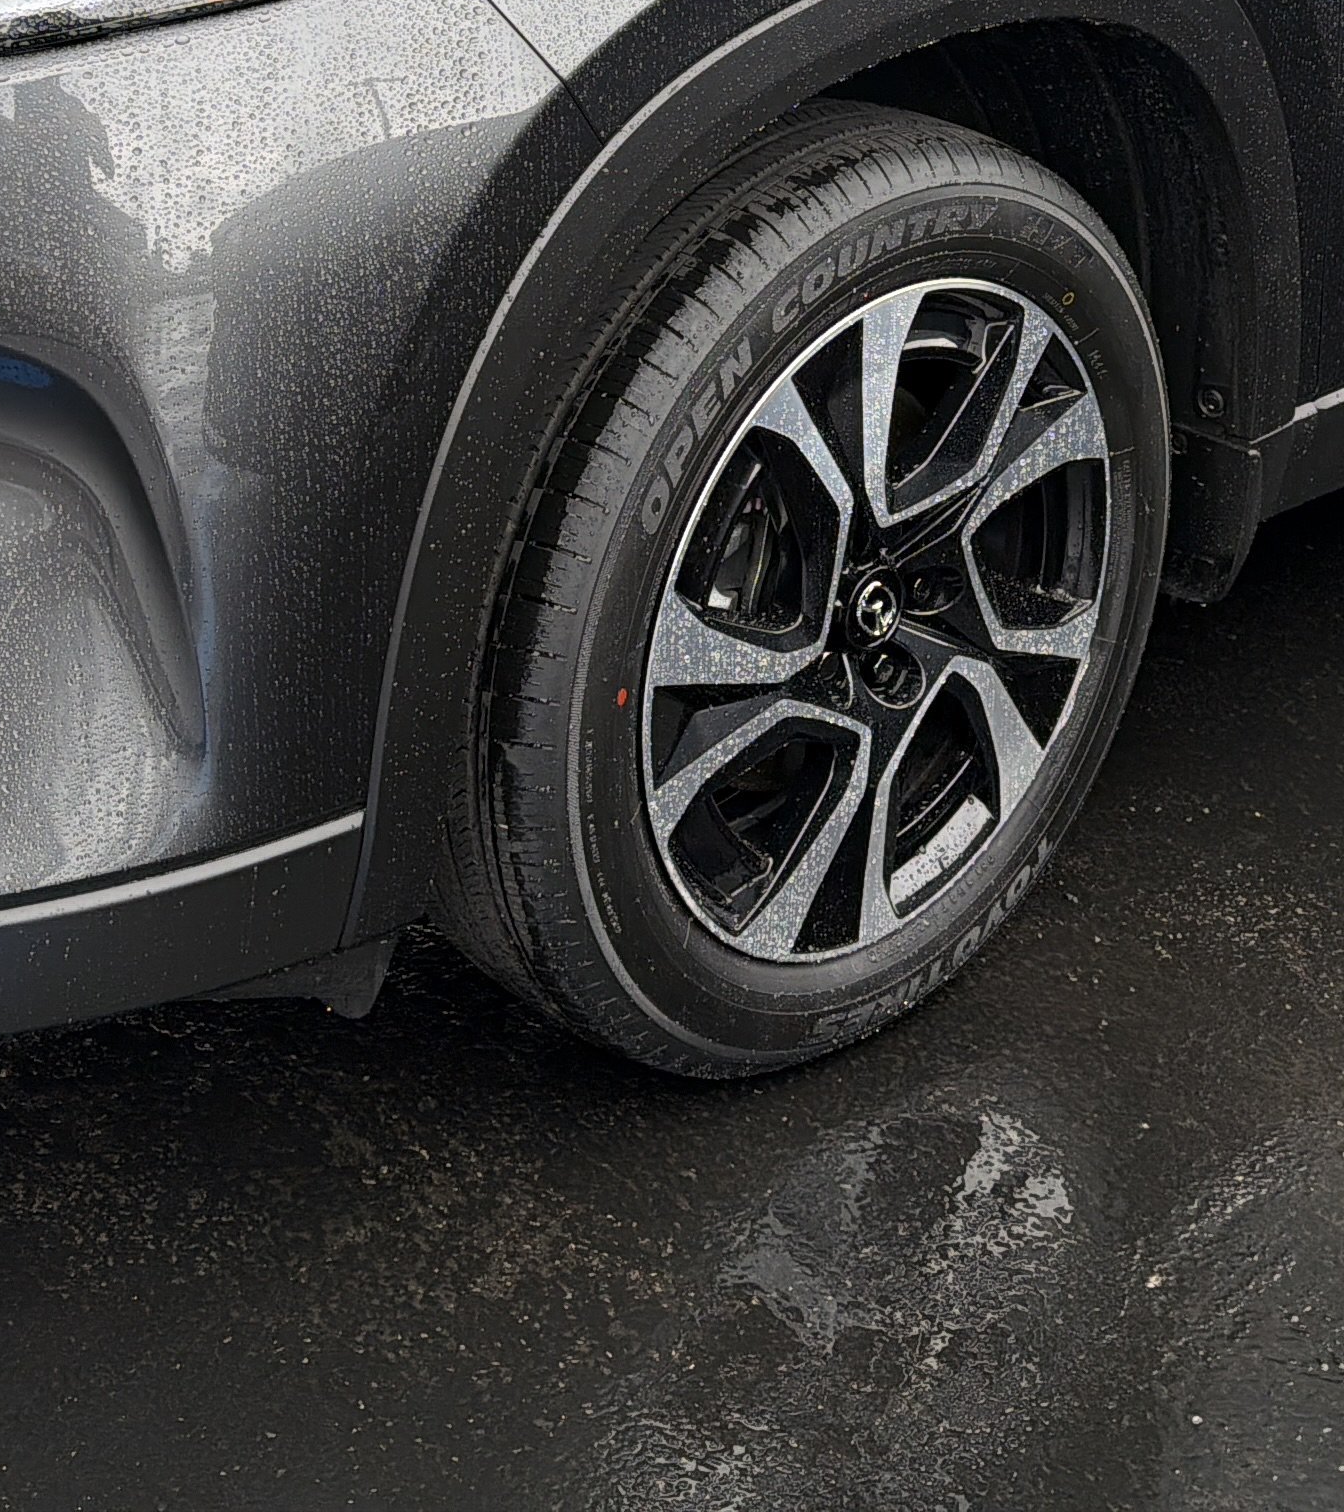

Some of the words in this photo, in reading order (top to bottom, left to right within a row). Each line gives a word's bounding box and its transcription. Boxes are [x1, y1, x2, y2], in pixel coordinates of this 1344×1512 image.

[640, 336, 753, 535] OPEN
[771, 204, 999, 334] COUNTRY
[953, 836, 1055, 966] TOYO
